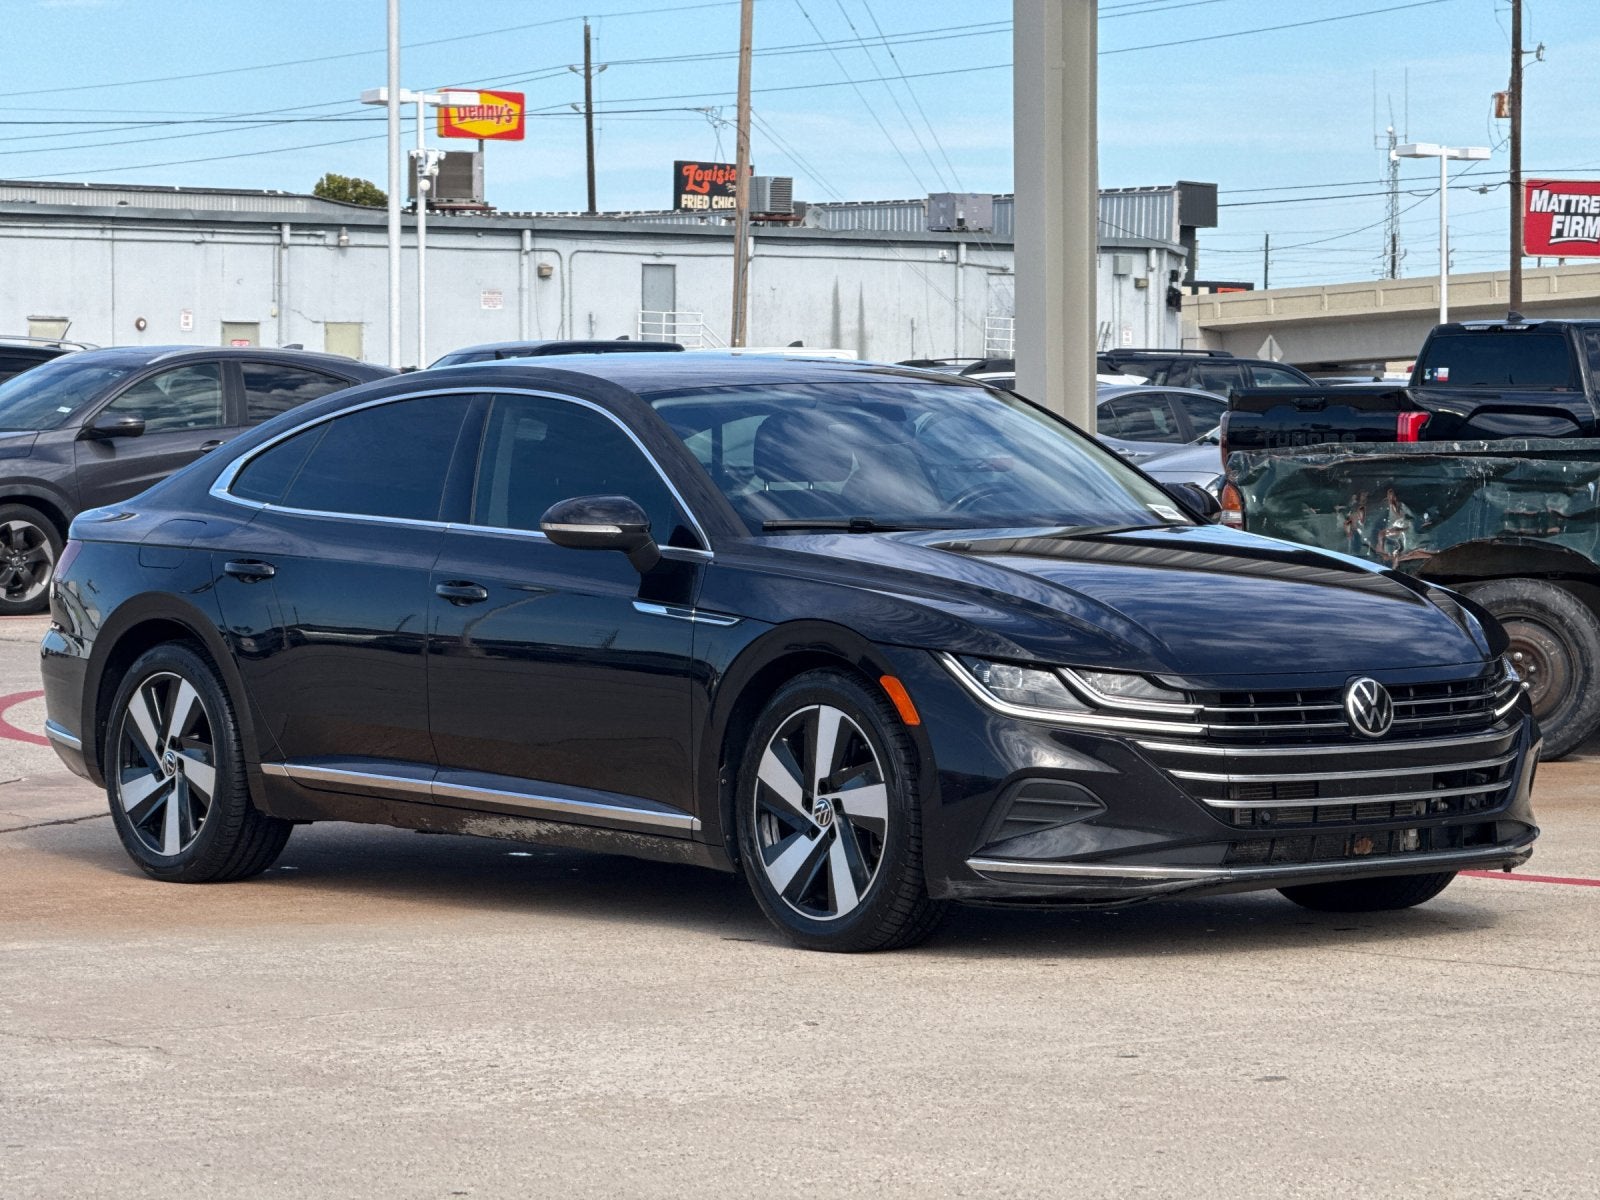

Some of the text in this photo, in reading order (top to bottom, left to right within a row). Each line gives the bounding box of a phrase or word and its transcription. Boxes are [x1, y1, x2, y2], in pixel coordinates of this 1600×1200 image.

[457, 104, 514, 125] Denny's
[683, 164, 737, 194] Louisia
[681, 194, 737, 209] FRIED CHIC
[1529, 189, 1600, 214] MATTRE
[1550, 214, 1600, 238] FIRM
